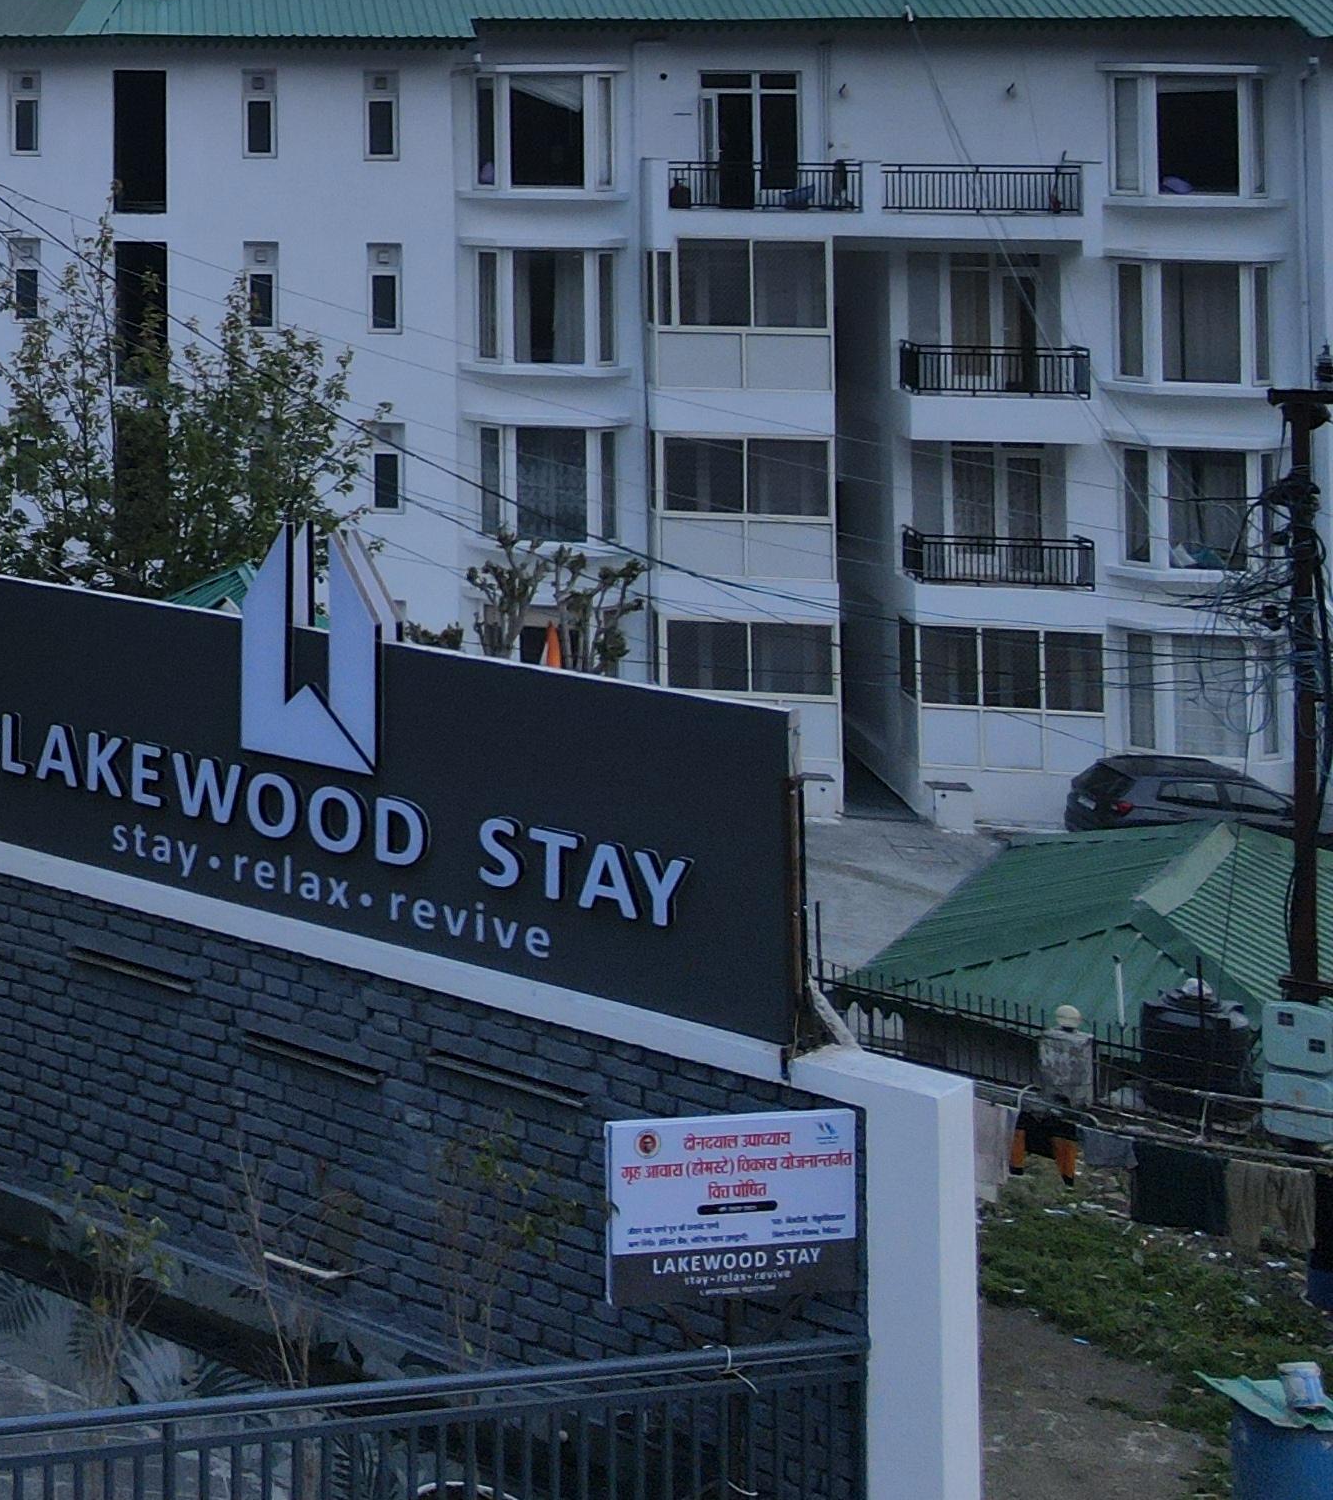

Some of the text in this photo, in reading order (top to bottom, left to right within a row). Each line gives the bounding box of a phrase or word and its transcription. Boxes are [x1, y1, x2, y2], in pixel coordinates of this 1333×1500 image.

[1, 711, 691, 928] LAKEWOOD STAY
[653, 1247, 821, 1275] LAKEWOOD STAY
